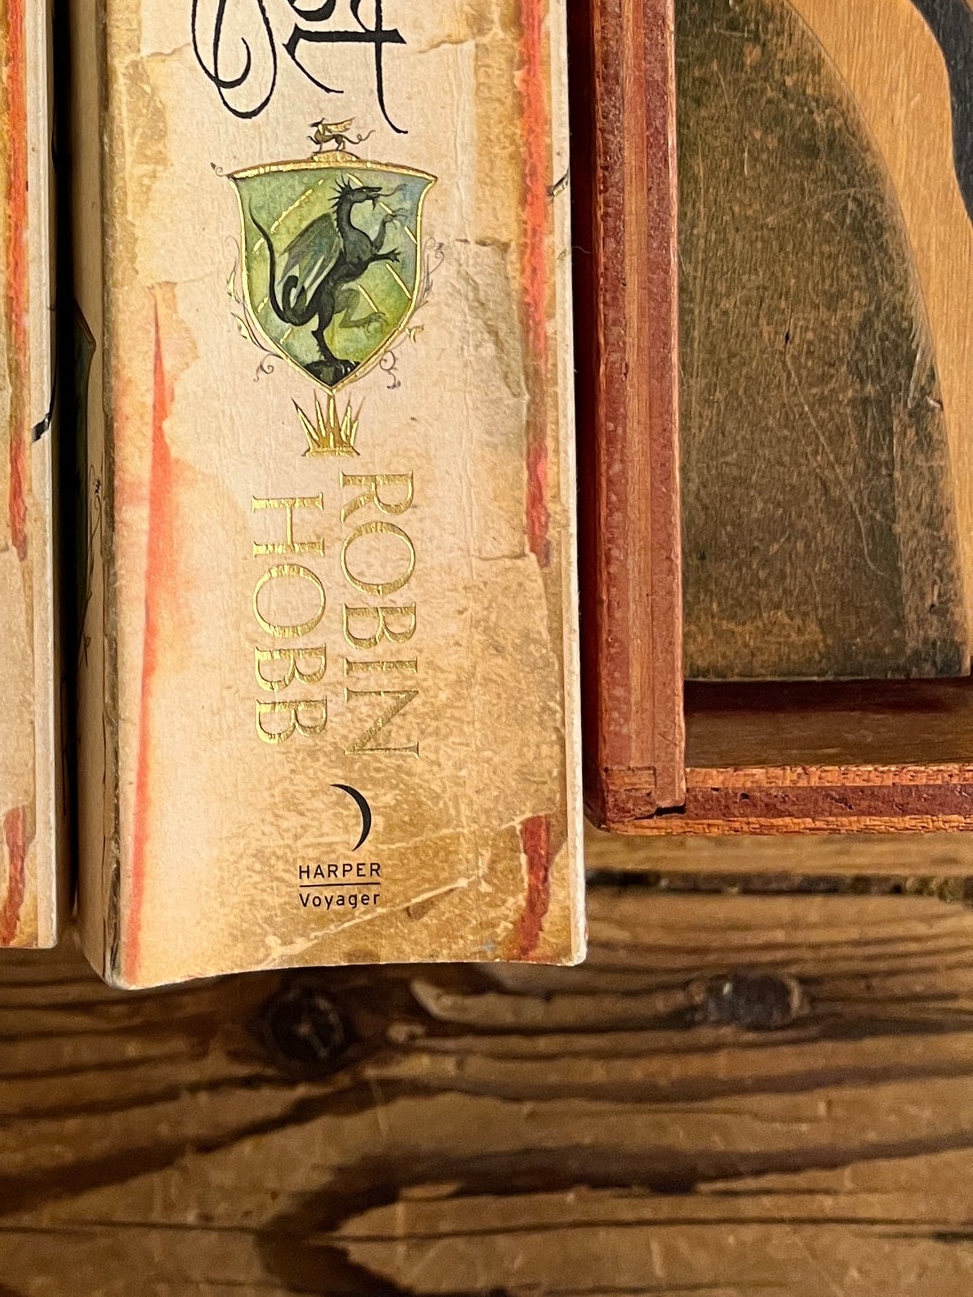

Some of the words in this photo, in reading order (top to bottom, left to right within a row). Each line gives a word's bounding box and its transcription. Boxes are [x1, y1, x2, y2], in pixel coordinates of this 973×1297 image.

[252, 493, 328, 746] HOBB
[339, 470, 421, 759] ROBIN
[298, 862, 382, 880] HARPER
[298, 890, 382, 910] Voyager
